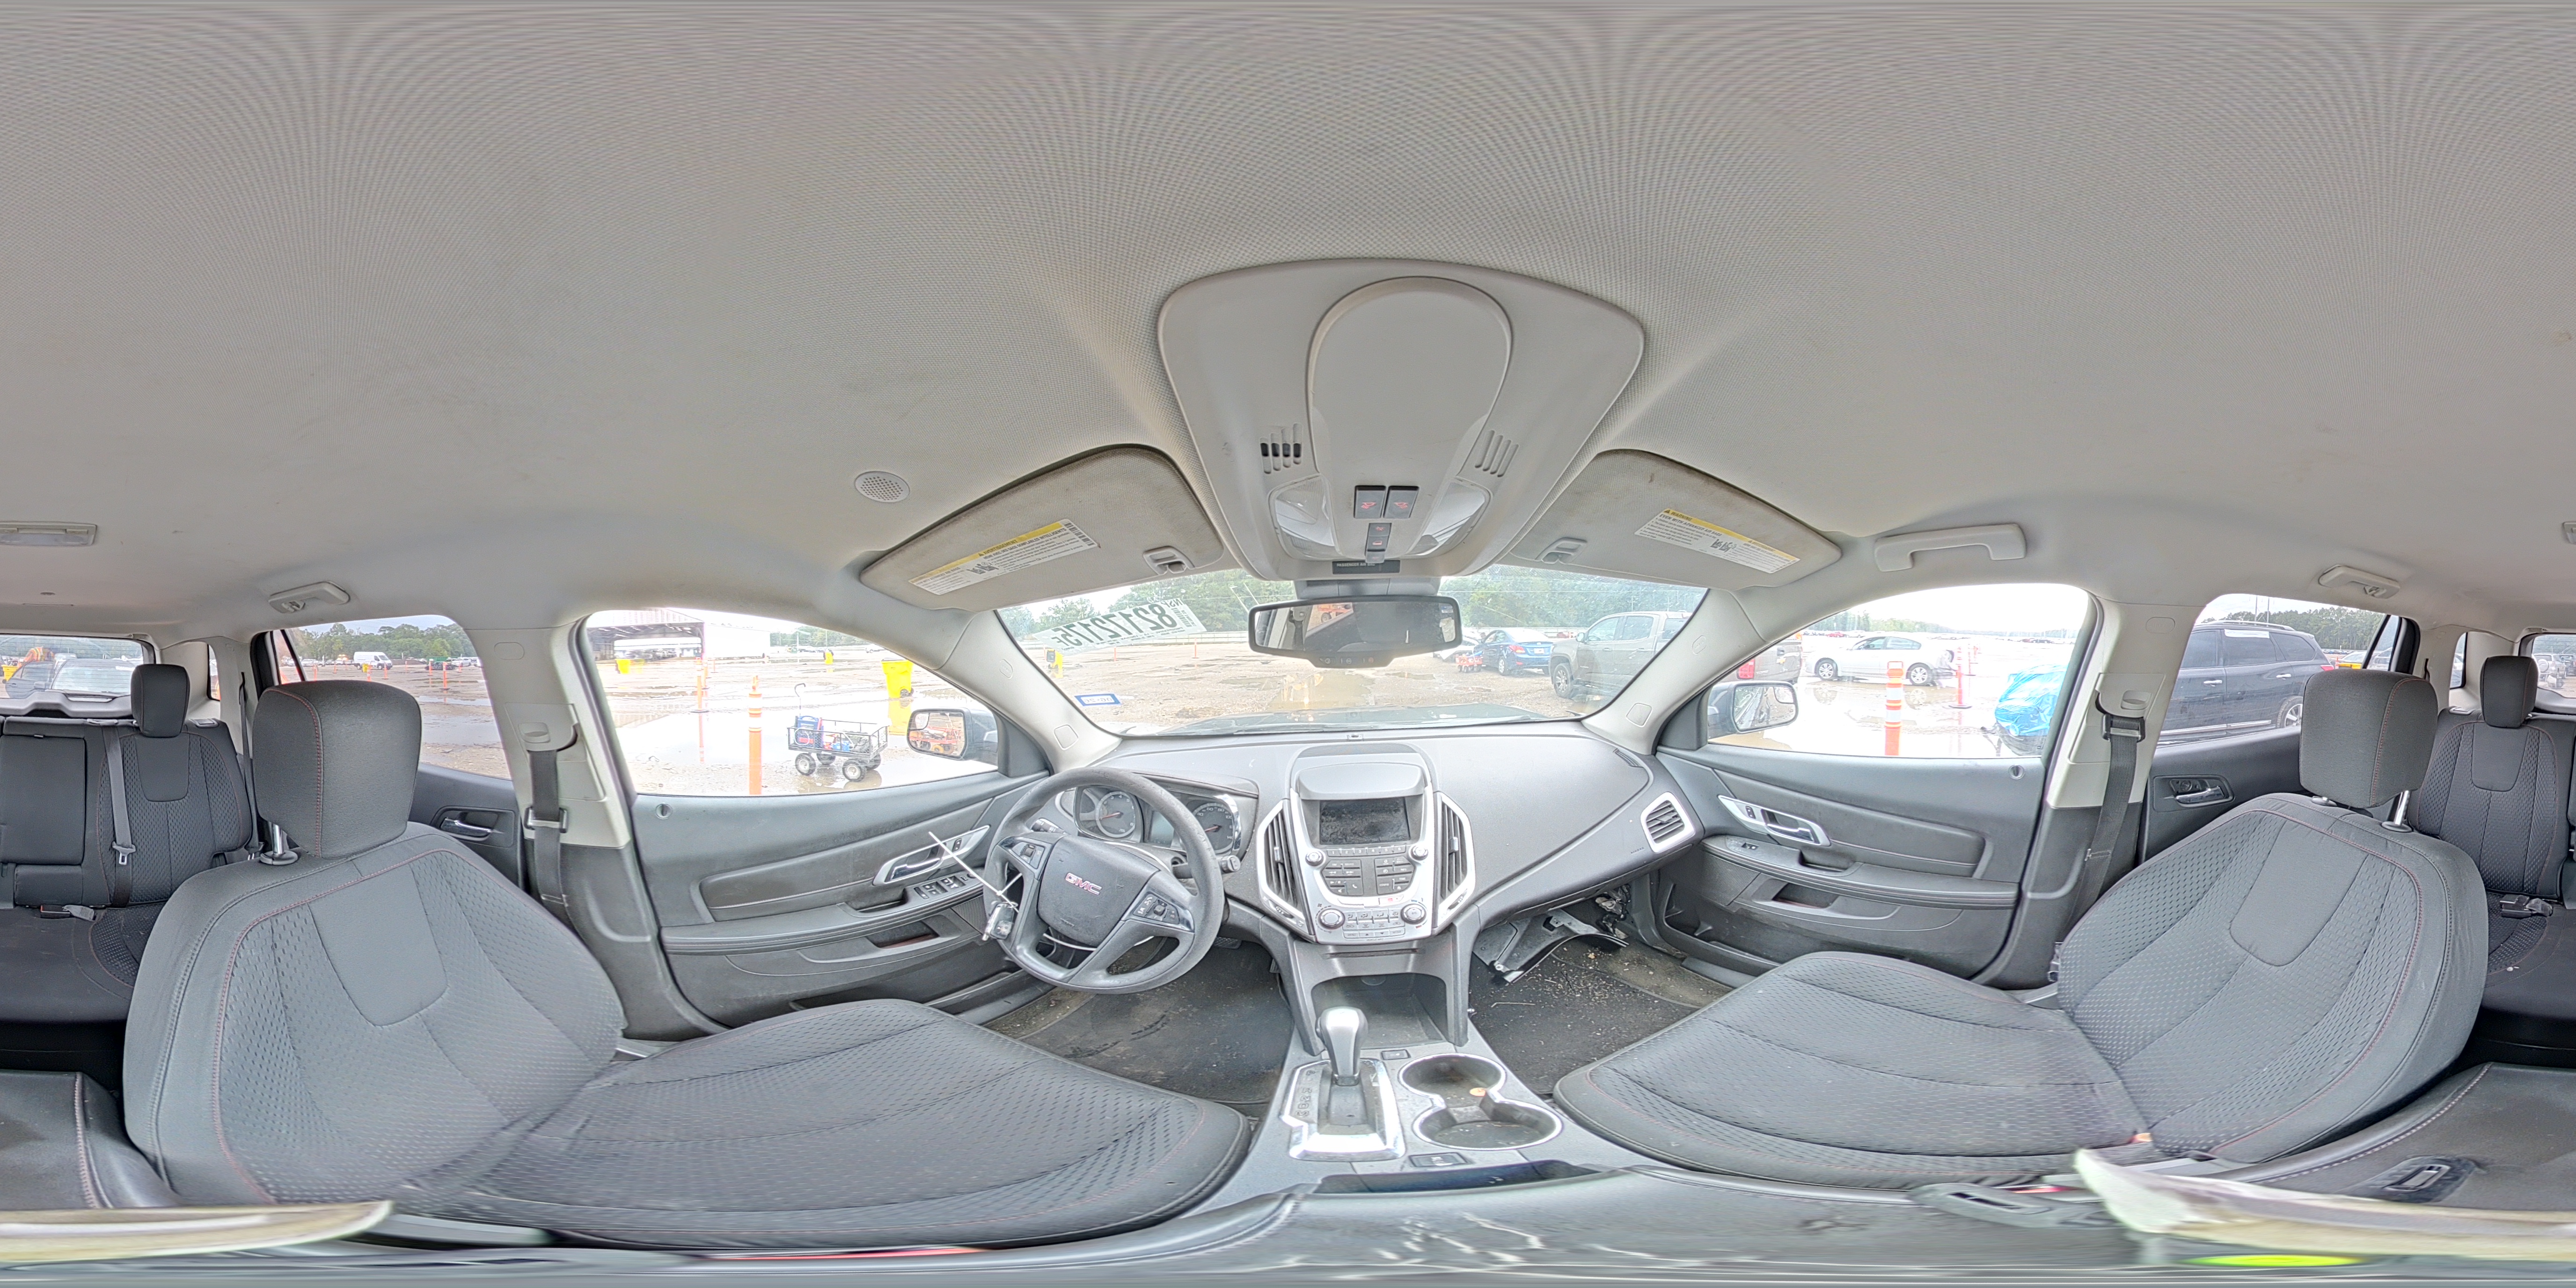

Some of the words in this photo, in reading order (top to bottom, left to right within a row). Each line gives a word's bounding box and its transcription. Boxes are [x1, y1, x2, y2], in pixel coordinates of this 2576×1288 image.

[1671, 511, 1693, 521] WARNING
[1683, 522, 1705, 531] ADVANCED
[1017, 537, 1039, 548] GONFLABLES
[1040, 527, 1067, 540] INTELLIGENTS
[983, 539, 1018, 556] AVERTISSEMENT
[1065, 872, 1102, 895] GMC
